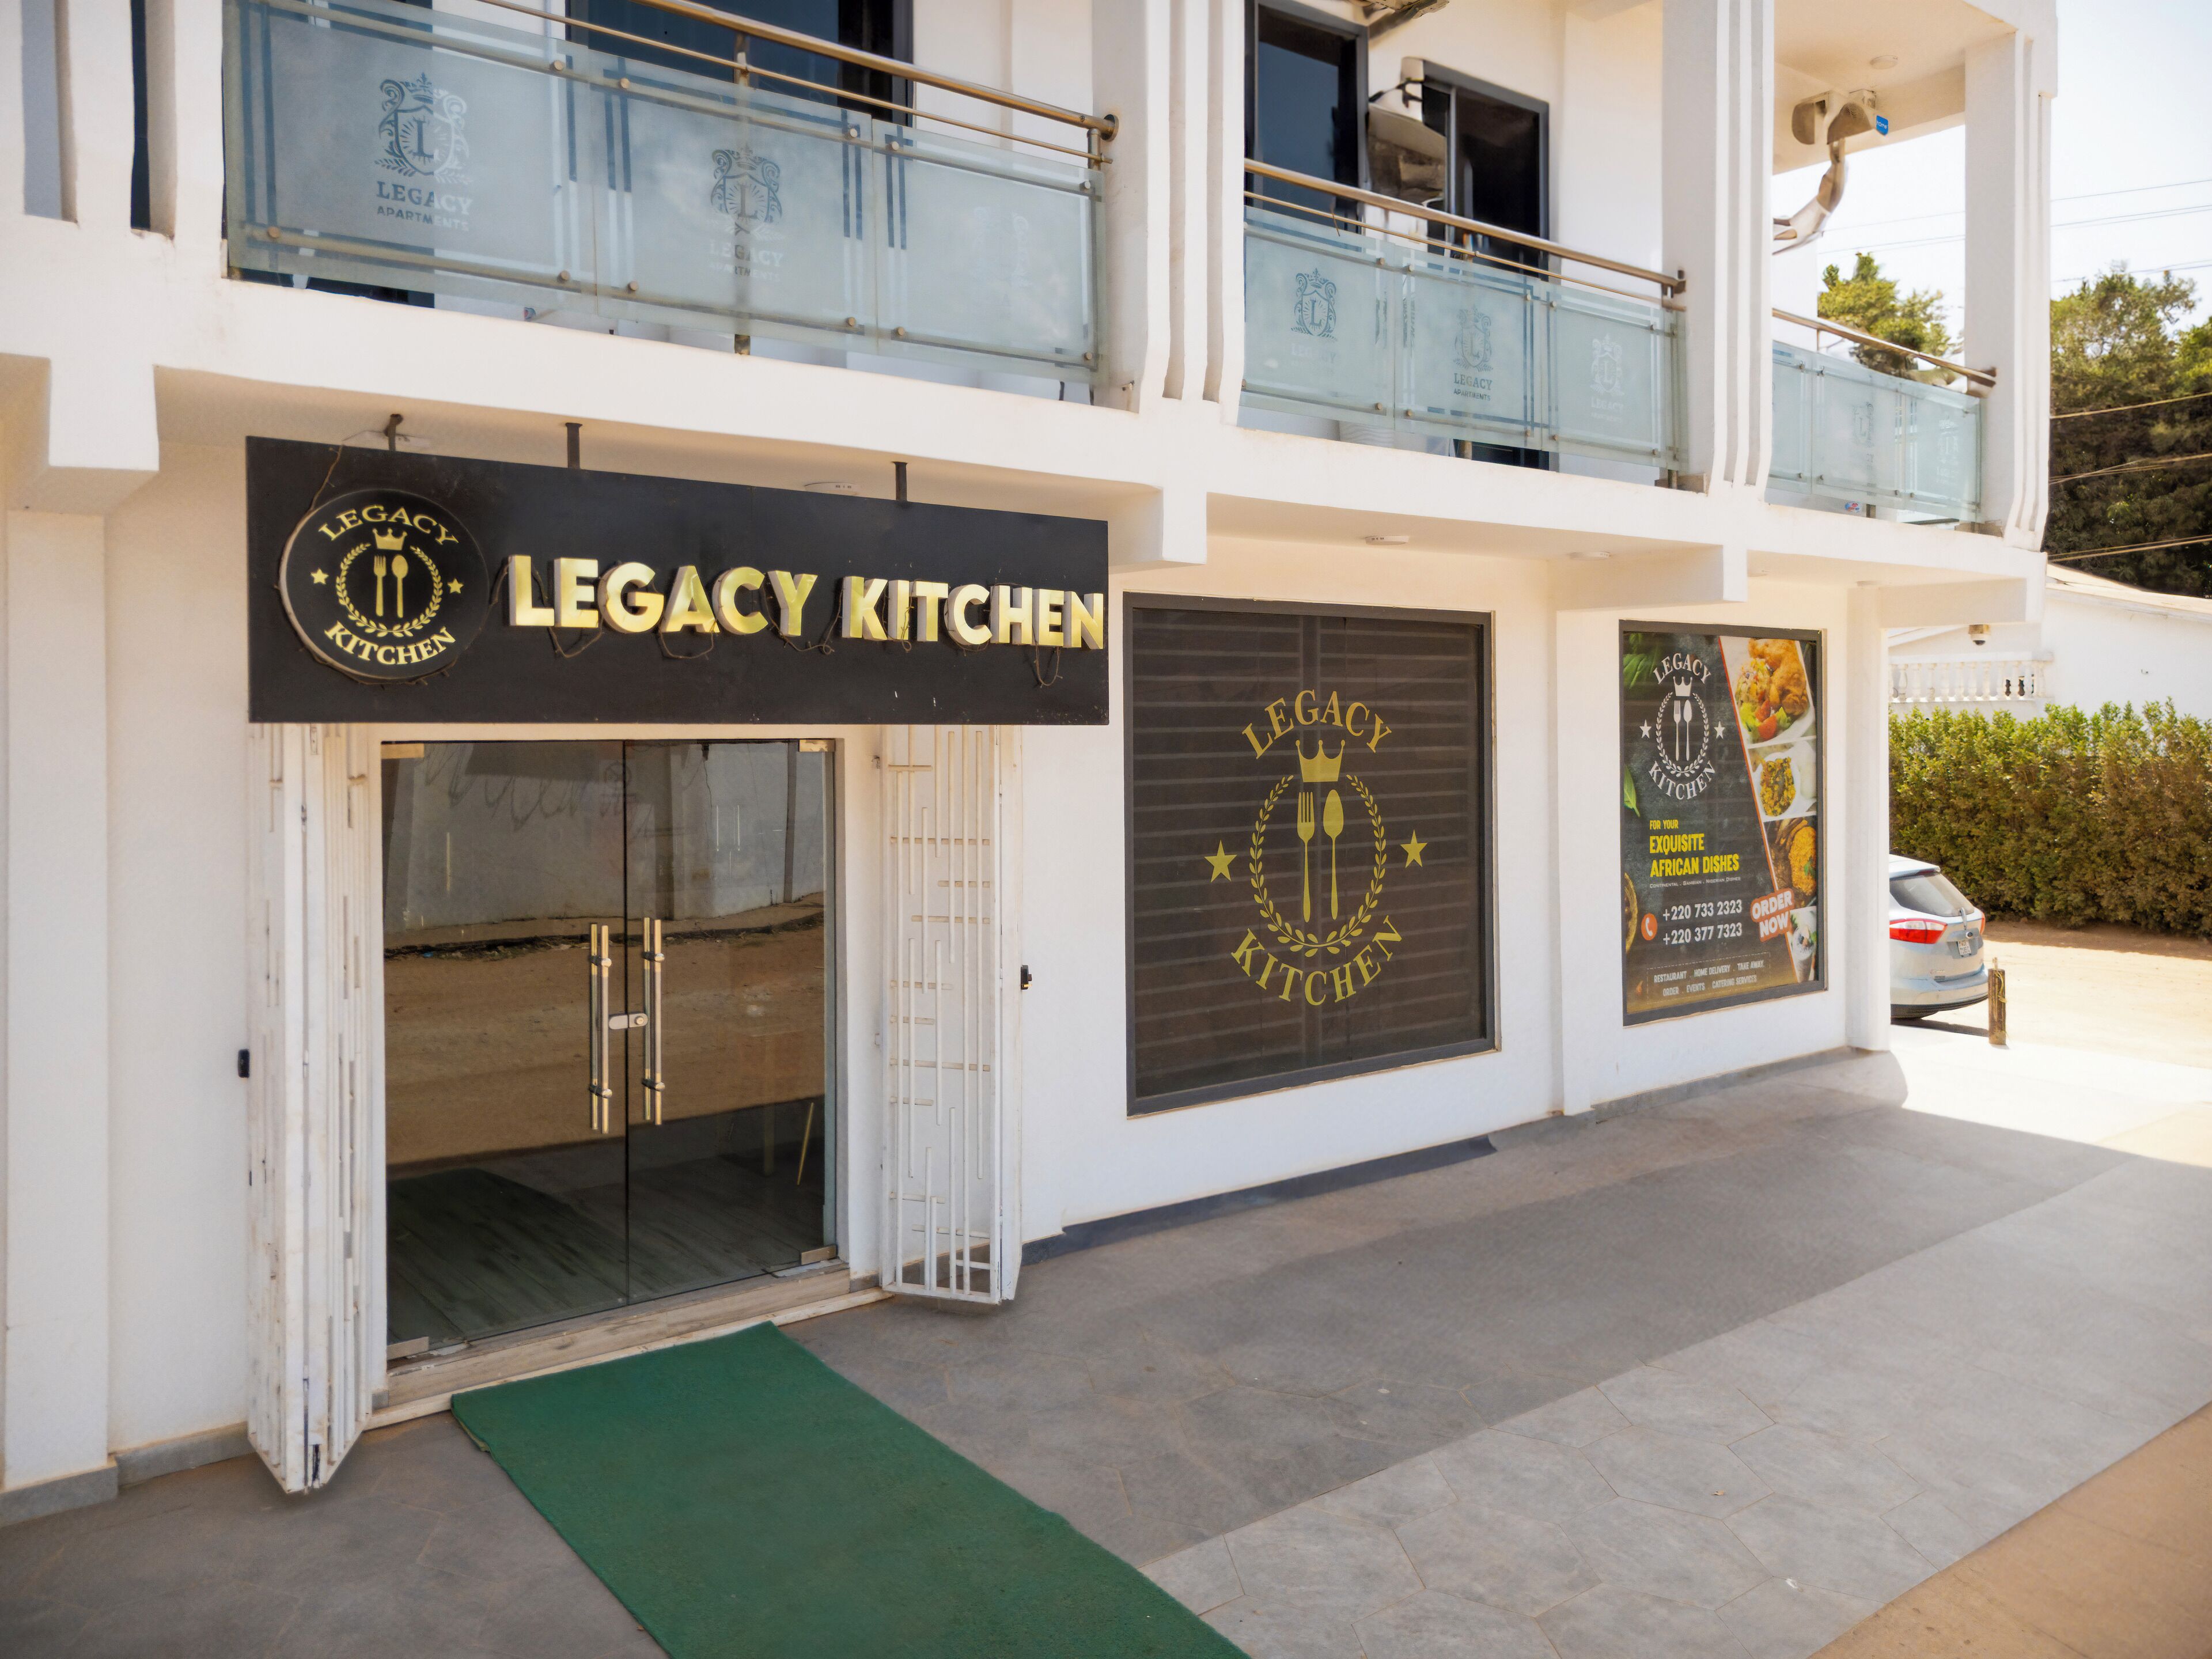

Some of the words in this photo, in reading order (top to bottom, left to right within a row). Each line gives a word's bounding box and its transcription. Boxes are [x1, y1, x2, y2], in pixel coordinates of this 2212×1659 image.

[376, 180, 473, 215] LEGACY
[709, 239, 784, 267] LEGACY
[1453, 372, 1493, 391] LEGACY
[1453, 388, 1491, 402] APARTMENTS
[319, 505, 459, 545] LEGACY
[507, 554, 817, 636] LEGACY
[843, 575, 1104, 650] KITCHEN
[324, 620, 456, 665] KITCHEN
[1653, 653, 1711, 685] LEGACY
[1242, 689, 1392, 760] LEGACY
[1649, 760, 1716, 801] KITCHEN
[1650, 820, 1661, 830] FOR
[1663, 819, 1679, 830] YOUR
[1650, 833, 1705, 855] EXQUISITE
[1650, 857, 1699, 877] AFRICAN
[1702, 853, 1740, 874] DISHES
[1662, 904, 1691, 921] +220
[1694, 902, 1714, 918] 733
[1717, 899, 1743, 916] 2323
[1752, 891, 1793, 920] ORDER
[1662, 928, 1691, 945] +220
[1694, 925, 1714, 942] 377
[1717, 922, 1743, 939] 7323
[1759, 911, 1789, 938] NOW
[1230, 915, 1404, 1006] KITCHEN
[1654, 971, 1687, 983] RESTAURANT
[1694, 968, 1708, 978] HOME
[1709, 964, 1730, 976] DELIVERY
[1737, 963, 1749, 971] TAKE
[1662, 986, 1679, 997] ORDER
[1686, 982, 1705, 993] EVENTS
[1712, 978, 1734, 989] CATERING
[1736, 974, 1757, 985] SERVICES
